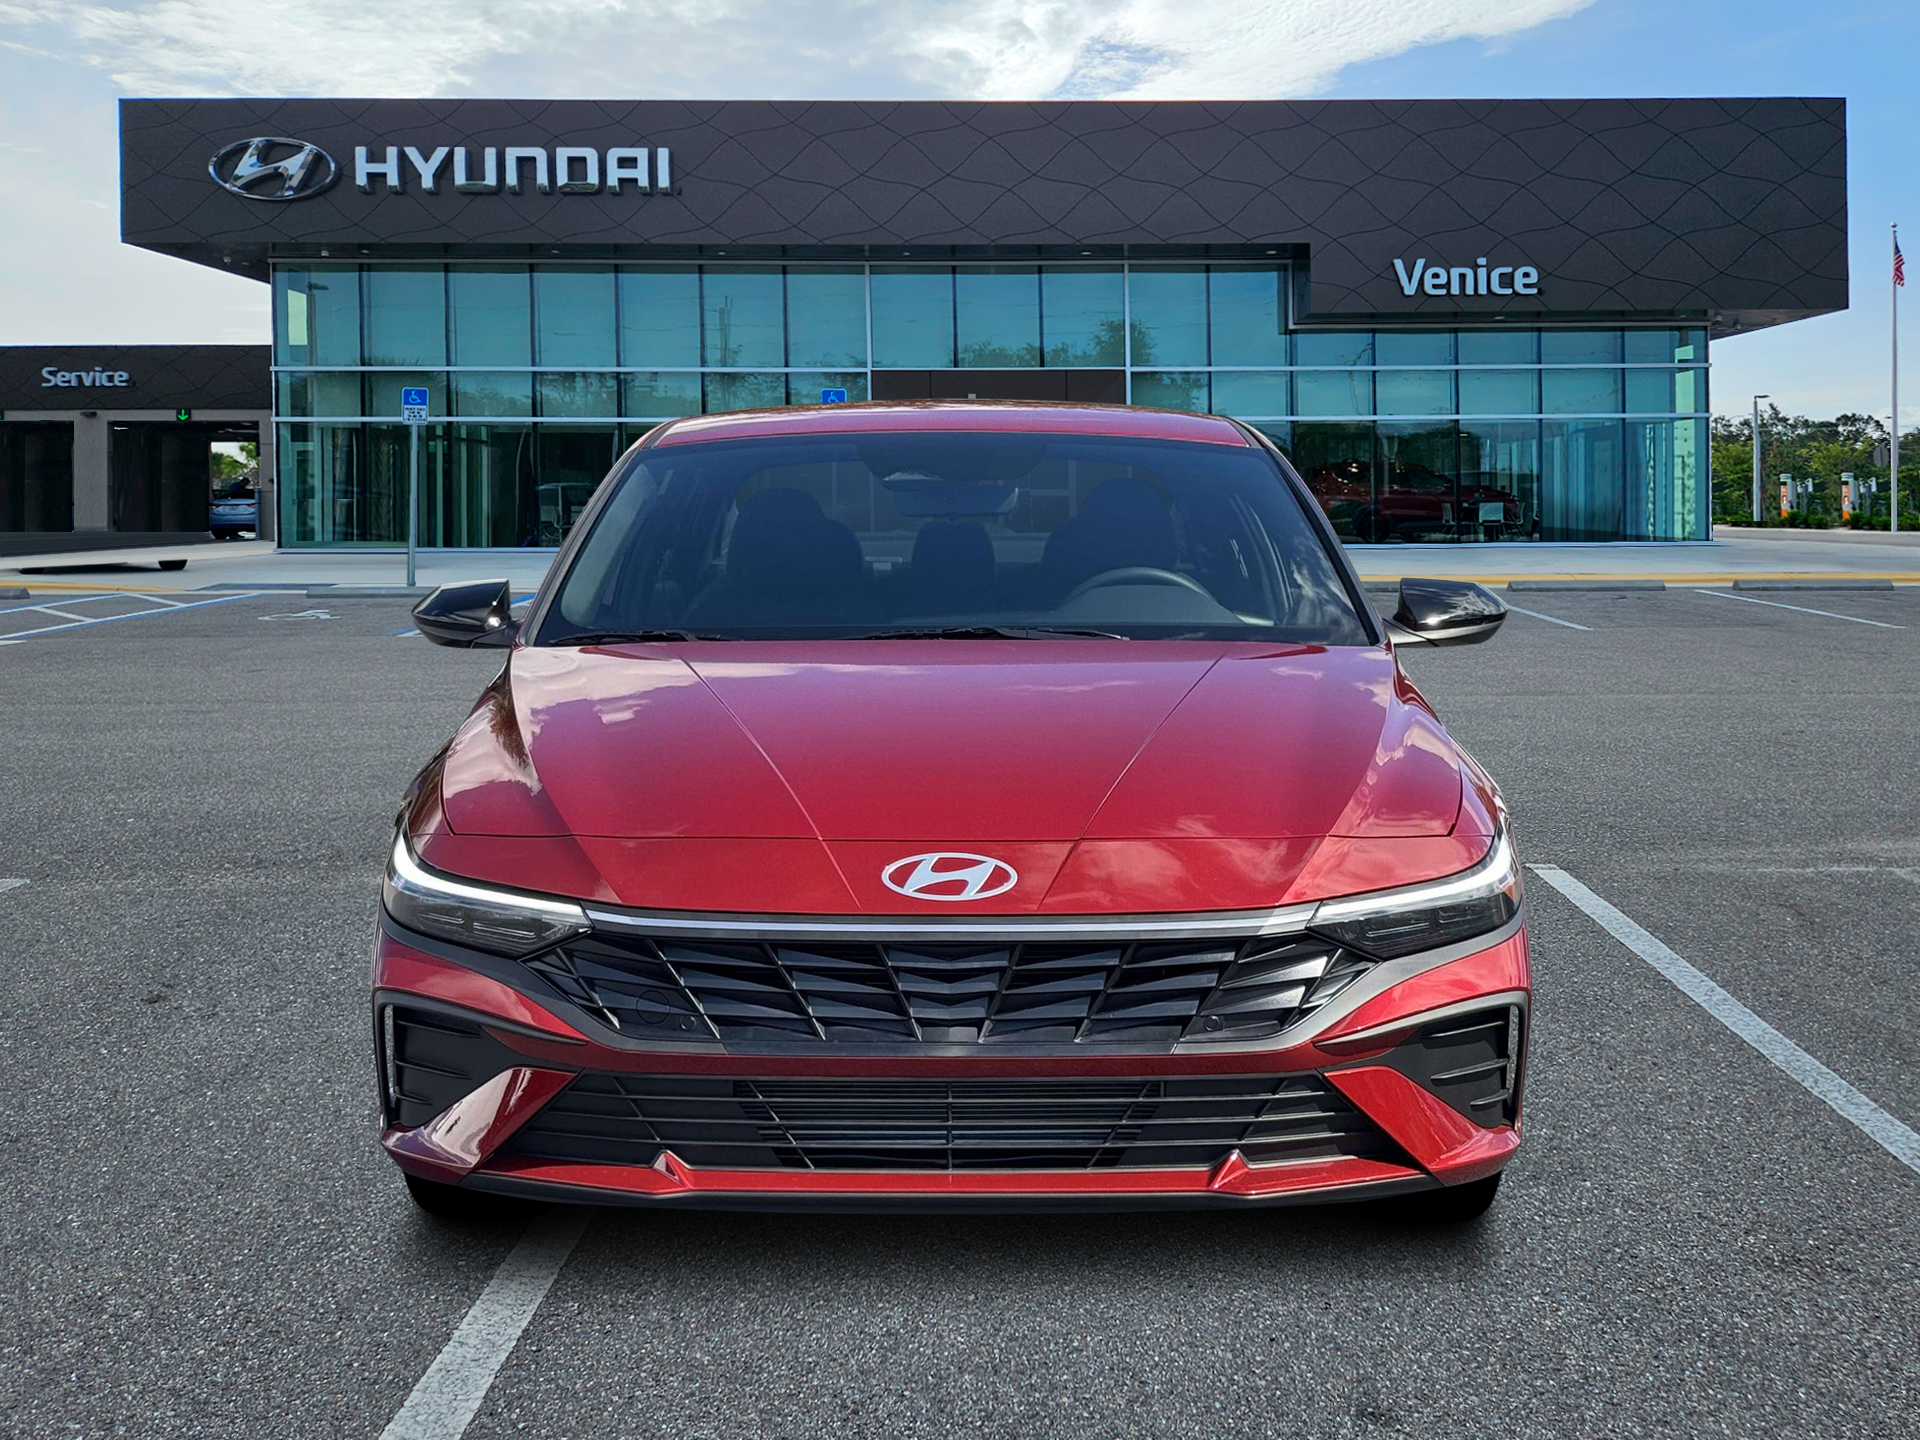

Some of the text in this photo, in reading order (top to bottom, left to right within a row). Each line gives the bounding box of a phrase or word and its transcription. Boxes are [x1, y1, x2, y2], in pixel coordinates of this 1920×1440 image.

[354, 146, 671, 194] HYUNDAI
[1393, 257, 1539, 295] Venice
[41, 366, 130, 387] Service
